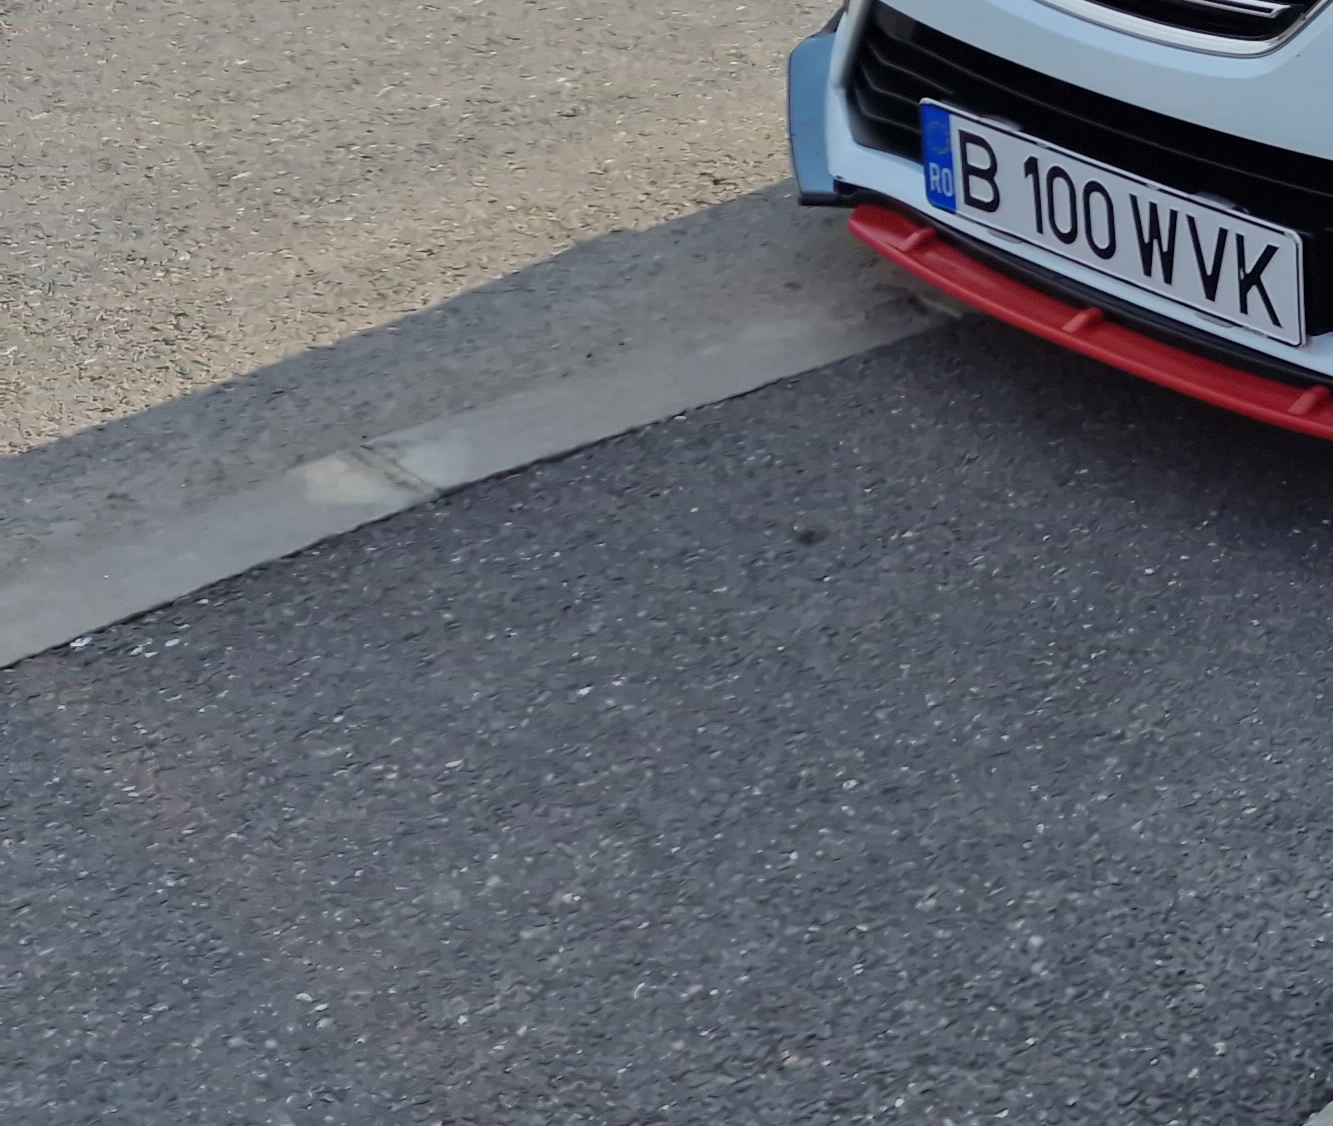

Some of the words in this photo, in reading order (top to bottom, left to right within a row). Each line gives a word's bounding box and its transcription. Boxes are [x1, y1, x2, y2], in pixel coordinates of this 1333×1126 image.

[928, 161, 954, 198] RO
[957, 129, 1000, 213] B
[1023, 155, 1117, 260] 100
[1128, 193, 1284, 328] WVK
